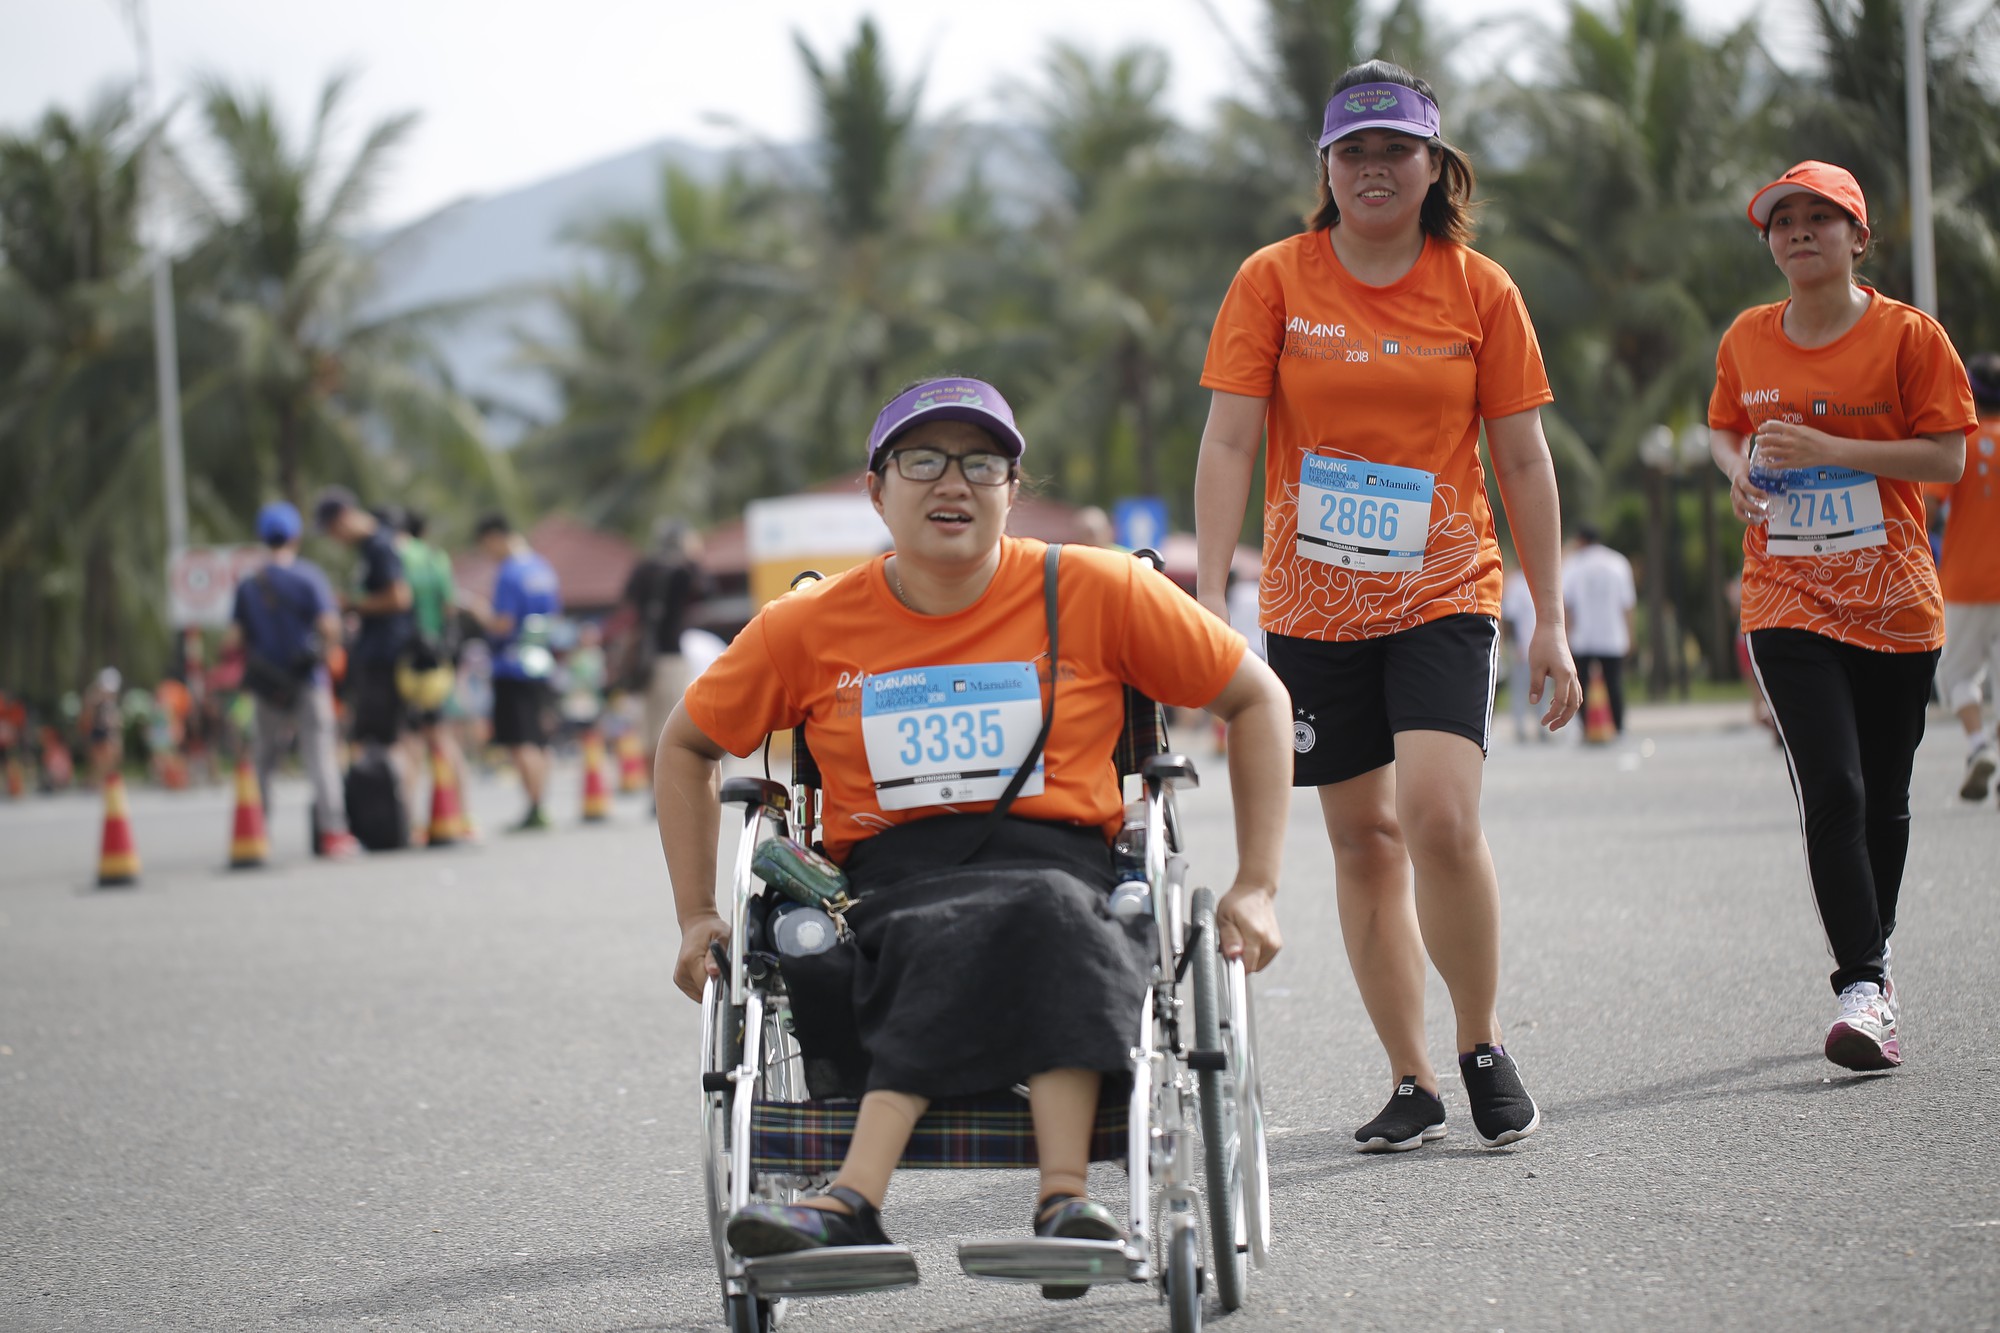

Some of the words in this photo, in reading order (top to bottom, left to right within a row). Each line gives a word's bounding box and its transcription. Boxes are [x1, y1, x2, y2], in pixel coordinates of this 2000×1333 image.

[1349, 92, 1365, 100] Born
[1284, 316, 1346, 337] ANANG
[1287, 331, 1365, 350] TERNATIONAL
[1345, 350, 1369, 362] 2018
[1741, 389, 1779, 406] ANANG
[1832, 402, 1893, 416] Manulife
[1782, 412, 1803, 424] 2018
[1309, 458, 1347, 473] DANANG
[1308, 474, 1346, 488] MARATHON
[1346, 481, 1360, 490] 2018
[1309, 467, 1357, 482] INTERNATIONAL
[1379, 478, 1421, 491] Manulife
[1788, 491, 1855, 528] 2741
[1320, 494, 1399, 541] 2866
[874, 672, 927, 692] DANANG
[970, 679, 1022, 692] Manulife
[898, 709, 1005, 766] 3335
